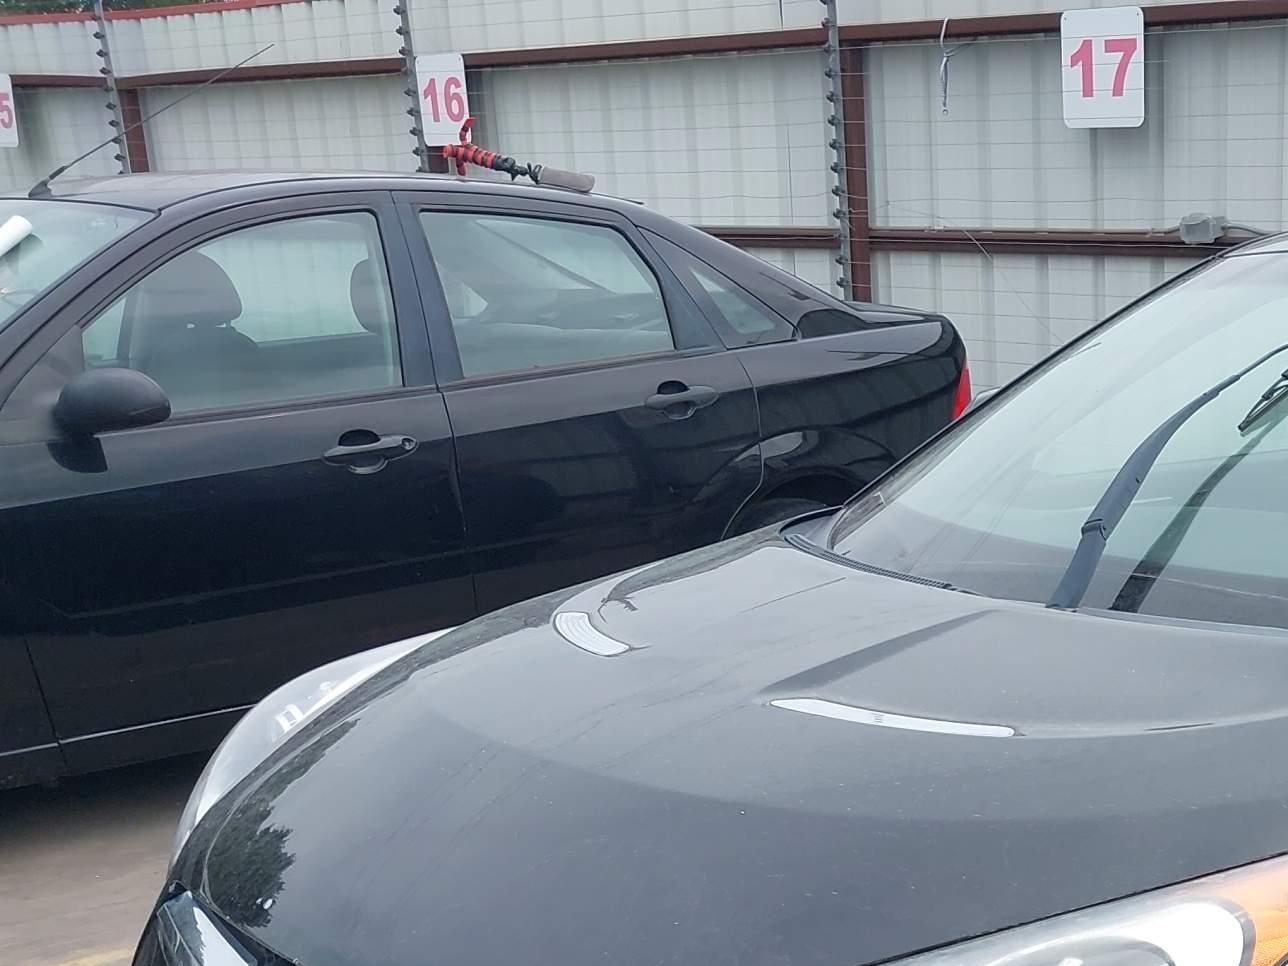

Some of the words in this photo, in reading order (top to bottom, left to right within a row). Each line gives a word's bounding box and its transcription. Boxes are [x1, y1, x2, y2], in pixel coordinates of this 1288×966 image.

[1070, 37, 1137, 98] 17
[0, 92, 14, 129] 5
[423, 76, 465, 123] 16
